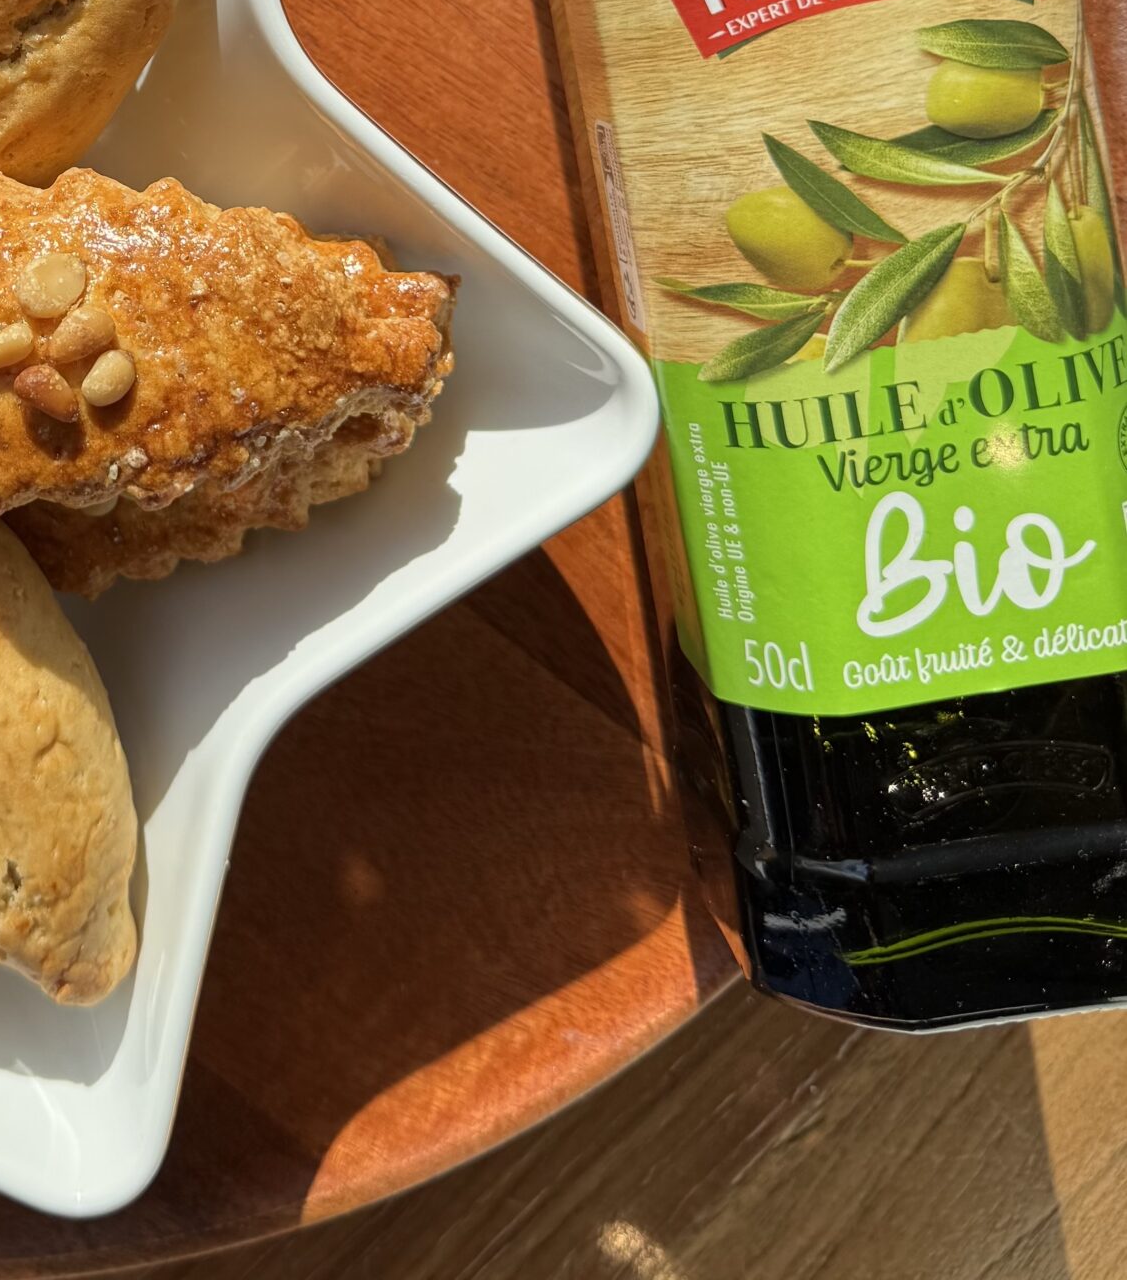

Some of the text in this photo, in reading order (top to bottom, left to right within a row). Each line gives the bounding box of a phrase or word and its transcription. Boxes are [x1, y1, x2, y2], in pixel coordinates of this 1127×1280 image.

[718, 333, 1127, 450] HUILE d'OLIVE
[688, 422, 734, 620] Huile d'olive vierge extra
[816, 442, 961, 492] Vierge
[711, 460, 756, 623] Origine UE & non-UE
[855, 490, 1098, 638] Bio
[743, 637, 816, 693] 50cl
[842, 652, 912, 690] Goût
[915, 636, 995, 685] fruité
[1000, 634, 1029, 664] &
